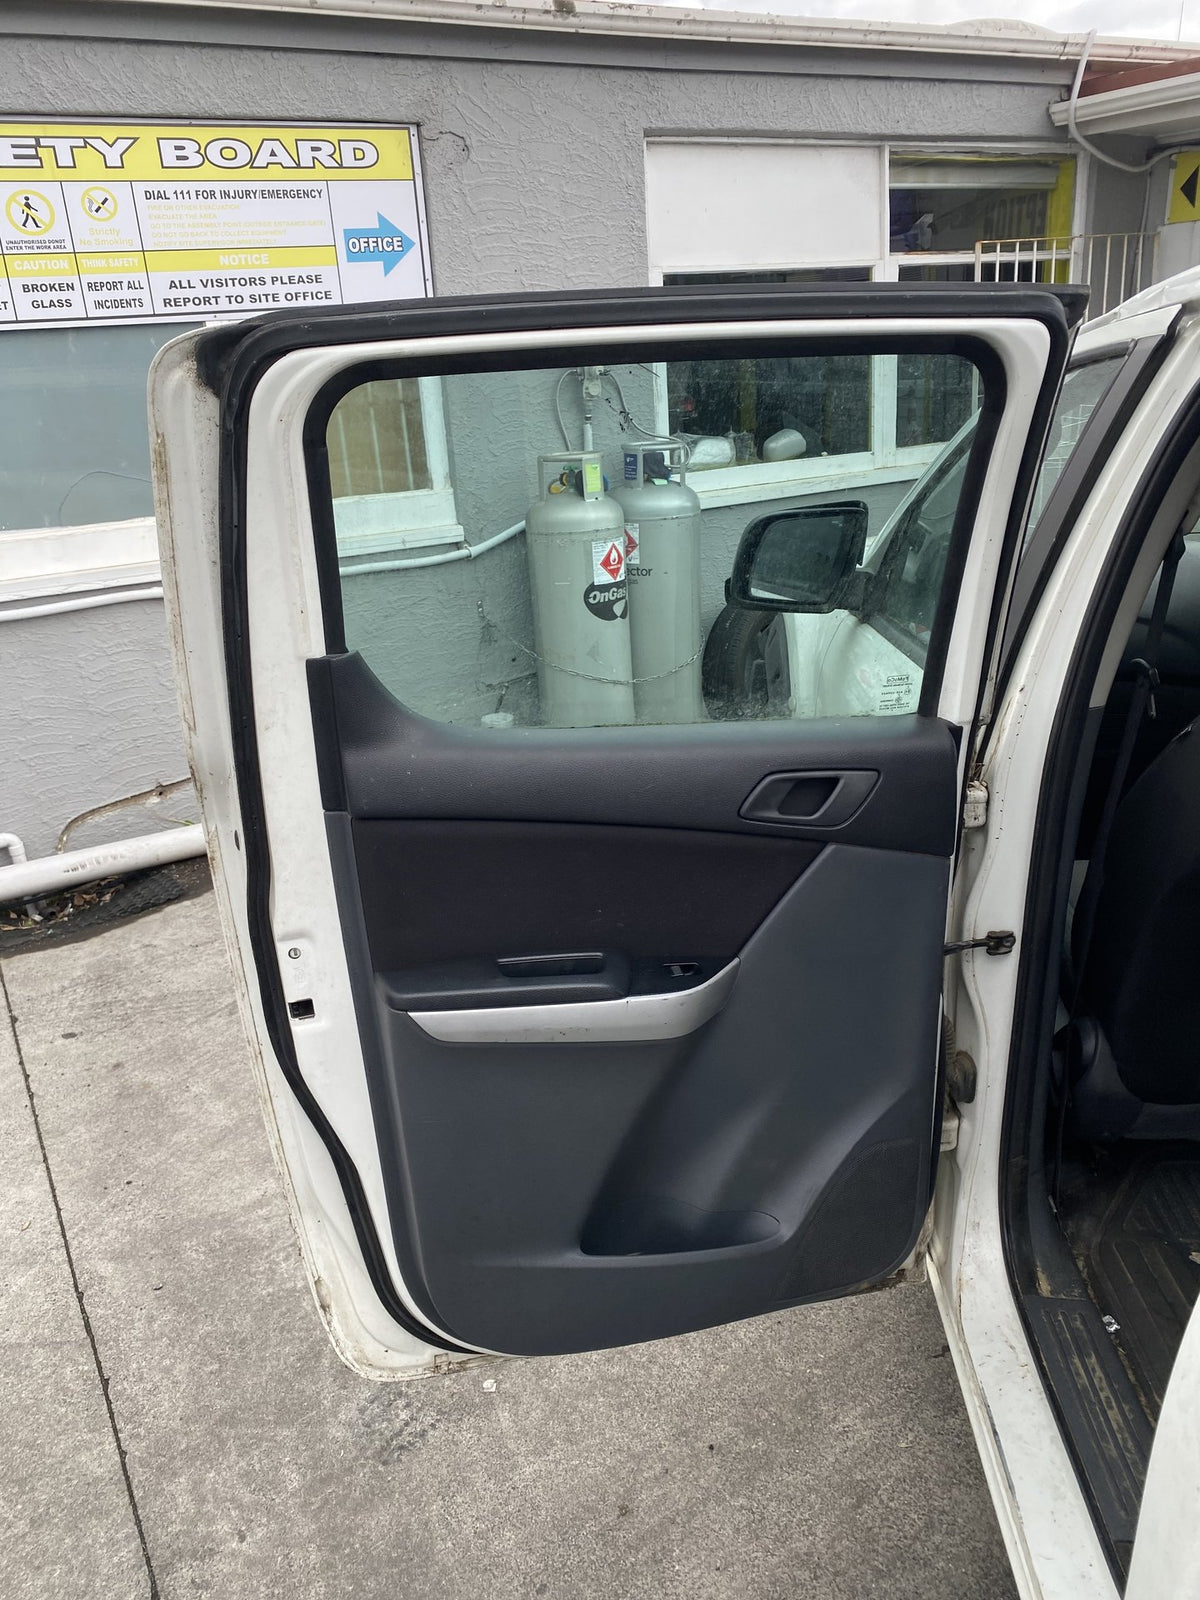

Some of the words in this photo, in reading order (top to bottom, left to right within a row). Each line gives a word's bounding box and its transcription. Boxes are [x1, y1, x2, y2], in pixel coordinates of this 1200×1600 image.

[156, 138, 379, 169] BOARD
[144, 190, 170, 200] DIAL
[173, 190, 191, 200] 111
[195, 190, 216, 200] FOR
[220, 189, 322, 200] INJURY/EMERGENCY
[95, 238, 134, 246] Smoking
[348, 237, 403, 254] OFFICE
[14, 260, 69, 270] CAUTION
[80, 258, 107, 268] THINK
[108, 258, 139, 267] SAFETY
[219, 254, 270, 266] NOTICE
[22, 282, 75, 293] BROKEN
[88, 281, 123, 292] REPORT
[127, 280, 144, 290] ALL
[169, 279, 196, 290] ALL
[200, 276, 267, 289] VISITORS
[271, 274, 322, 285] PLEASE
[31, 299, 72, 309] GLASS
[94, 298, 144, 310] INCIDENTS
[163, 296, 221, 308] REPORT
[226, 294, 244, 305] TO
[249, 292, 280, 303] SITE
[284, 290, 332, 302] OFFICE
[588, 586, 626, 604] OnGas
